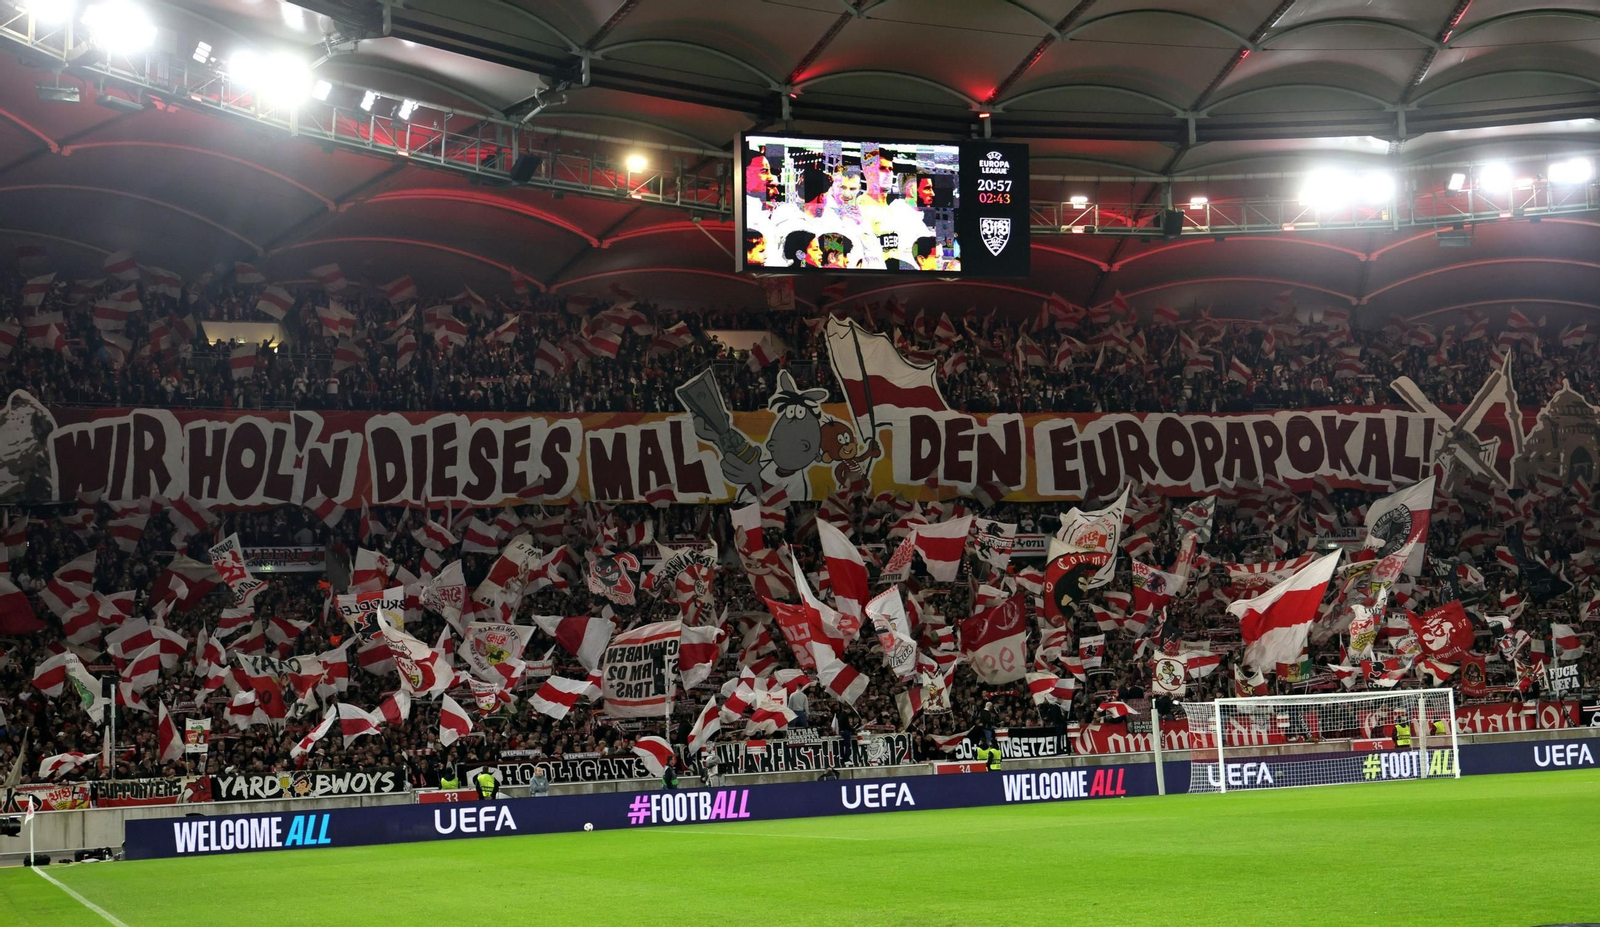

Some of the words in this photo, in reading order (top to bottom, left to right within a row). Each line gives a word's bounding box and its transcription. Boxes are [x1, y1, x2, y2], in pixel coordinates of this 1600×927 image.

[979, 160, 1010, 168] EUROPA
[977, 179, 1012, 192] 20:57
[979, 192, 1011, 204] 02:43
[53, 412, 172, 500] WIR
[370, 421, 572, 502] DIESES
[589, 420, 712, 501] MAL
[909, 414, 1021, 491] DEN
[1048, 415, 1436, 498] EUROPAPOKAL!
[1025, 539, 1045, 548] 0711
[1549, 663, 1579, 679] FUCK
[1551, 676, 1581, 691] UEFA
[1533, 742, 1595, 768] UEFA
[217, 773, 280, 800] YARD
[315, 770, 396, 794] BWOYS
[500, 757, 650, 787] HOOLIGANS
[1002, 770, 1088, 802] WELCOME
[1089, 768, 1127, 797] ALL
[98, 777, 182, 800] SUPPORTERS
[841, 782, 916, 810] UEFA
[434, 805, 517, 834] UEFA
[627, 789, 751, 825] #FOOTBALL
[173, 816, 283, 853] WELCOME
[284, 813, 332, 846] ALL
